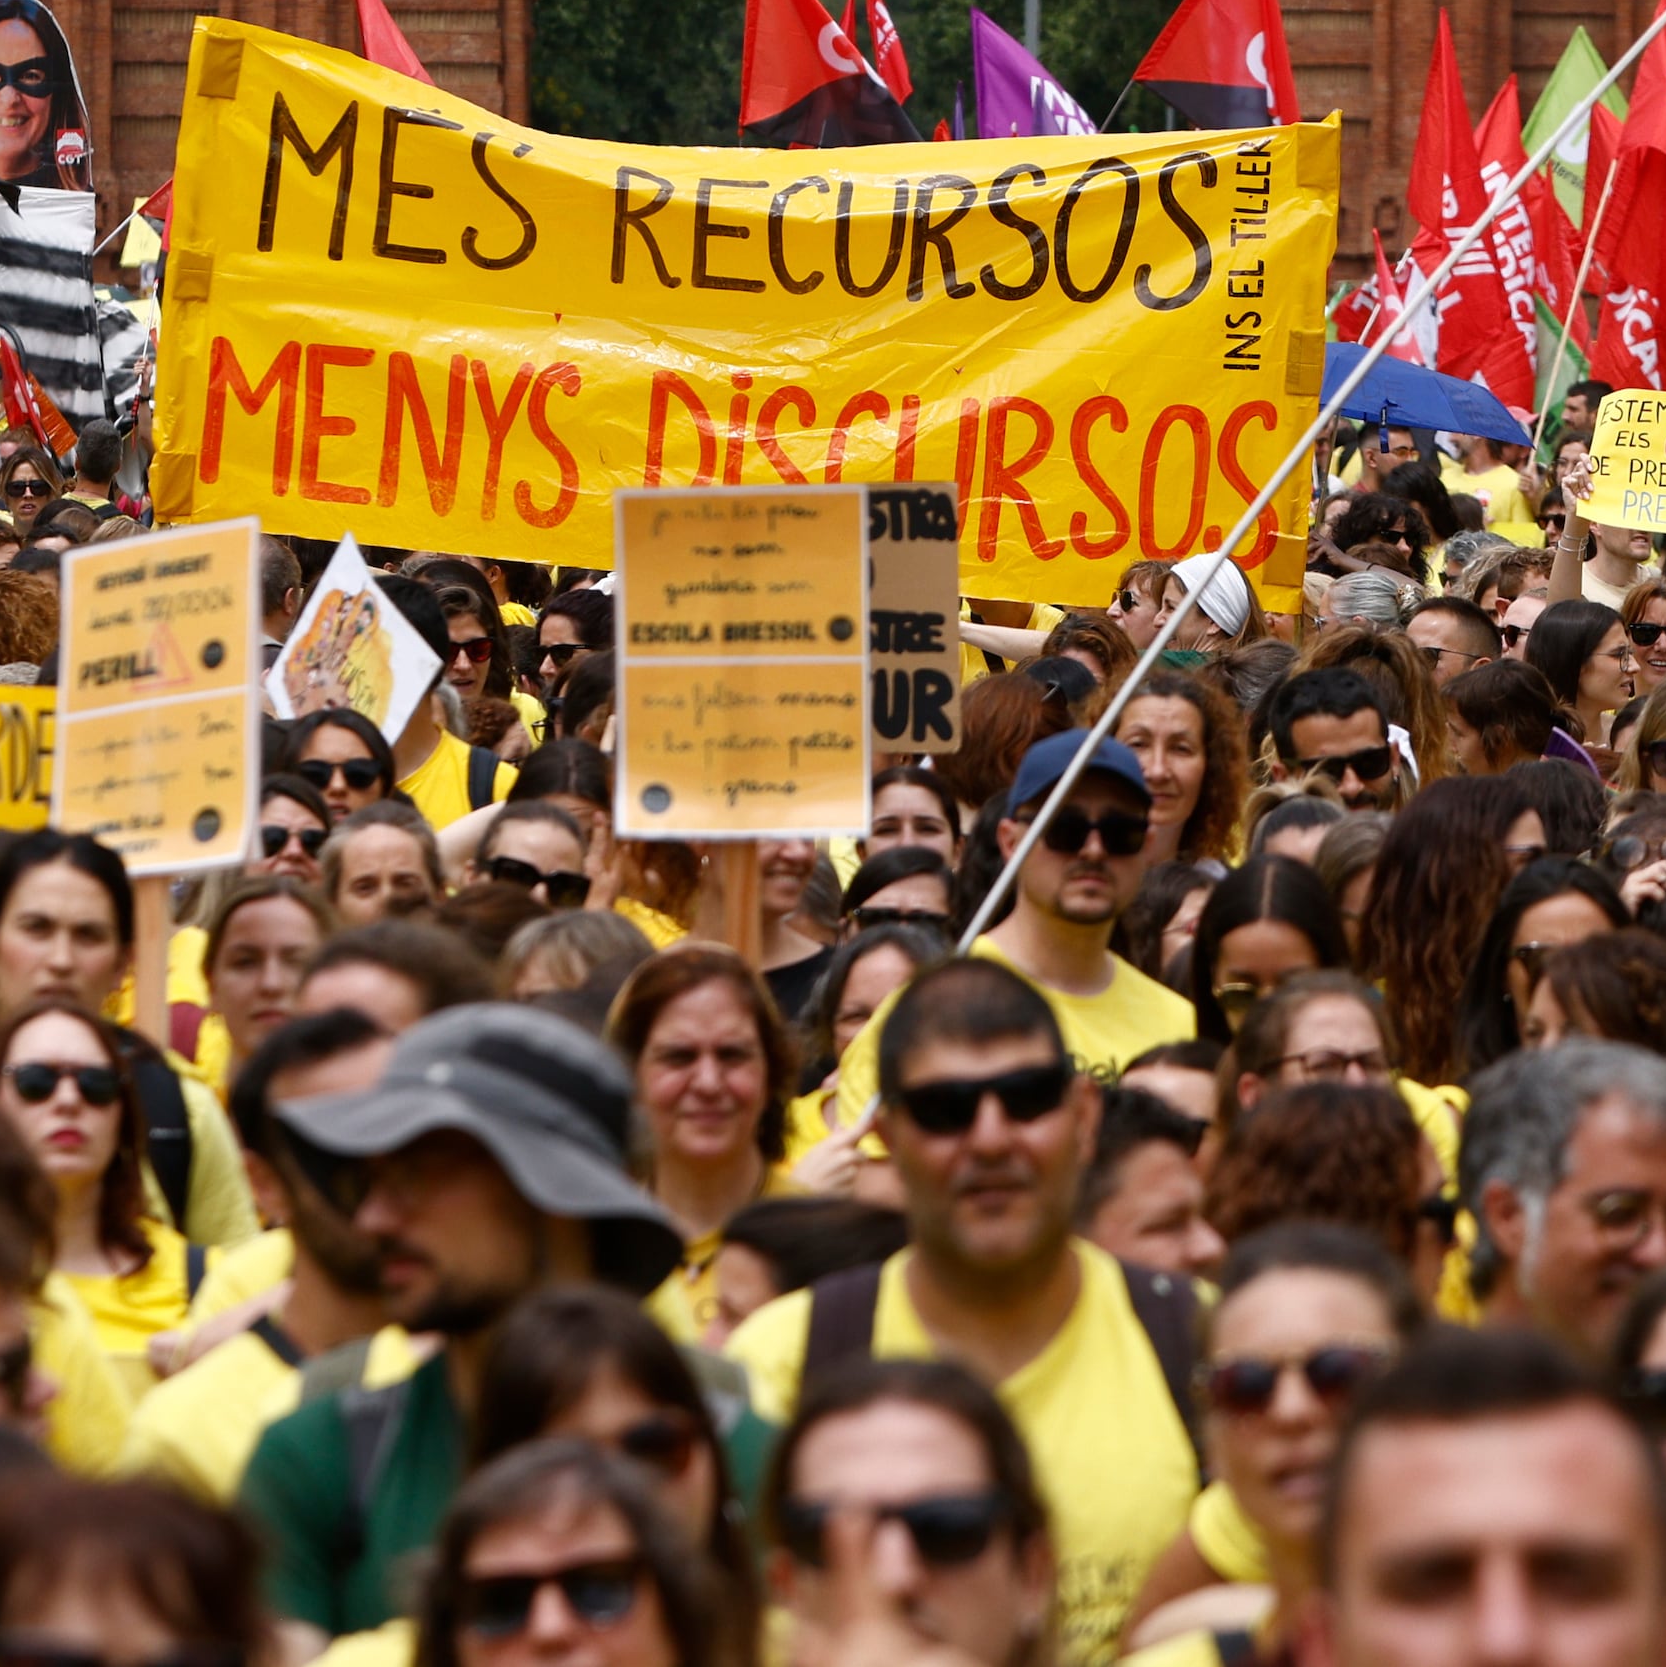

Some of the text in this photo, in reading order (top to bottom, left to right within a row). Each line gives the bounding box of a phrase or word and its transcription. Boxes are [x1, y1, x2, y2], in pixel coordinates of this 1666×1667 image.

[57, 152, 83, 165] CGT
[610, 148, 1218, 312] RECURSOS
[1227, 259, 1265, 299] EL
[1222, 311, 1262, 371] INS
[199, 335, 582, 529] MENYS
[1614, 430, 1651, 449] ELS
[1588, 455, 1612, 477] DE
[630, 619, 820, 645] ESCOLA BRESSOL
